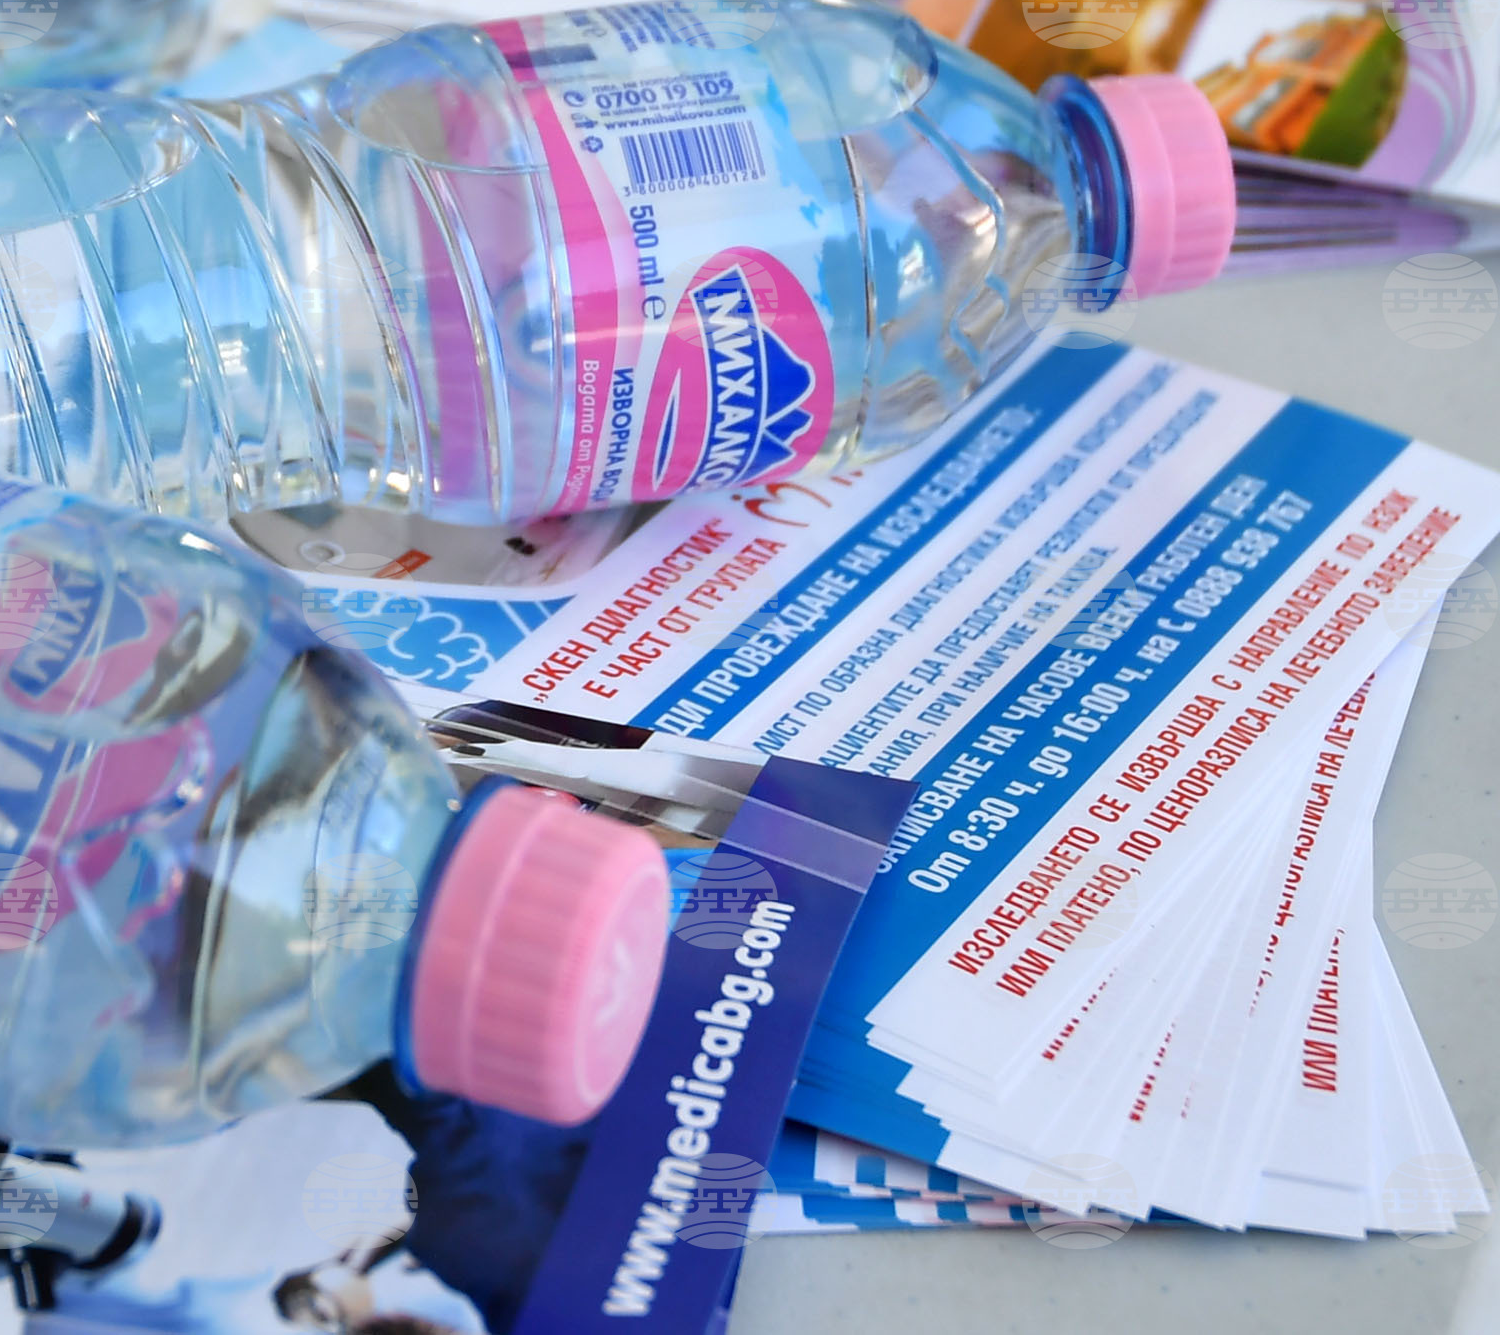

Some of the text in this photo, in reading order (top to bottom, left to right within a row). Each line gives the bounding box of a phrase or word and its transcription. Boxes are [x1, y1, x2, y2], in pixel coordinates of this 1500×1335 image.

[595, 87, 658, 110] 0700
[663, 84, 688, 101] 19
[692, 78, 735, 97] 109
[604, 104, 747, 130] www.mihalkovo.com
[630, 204, 659, 248] 500
[638, 257, 664, 287] ml
[605, 367, 633, 468] ИЗВОРНА
[702, 291, 756, 488] МИХАЛКО
[583, 538, 788, 700] Е ЧАСТ ОТ ГРУПАТА
[700, 569, 860, 705] ПРОВЕЖДАНЕ
[836, 542, 891, 576] НА
[794, 691, 831, 717] ПО
[821, 628, 904, 692] ОБРАЗНА
[890, 529, 1005, 631] ДИАГНОСТИКА
[908, 851, 972, 894] От
[948, 797, 1020, 852] 8:30
[1028, 745, 1073, 779] до
[1052, 681, 1131, 743] 16:00
[1136, 634, 1180, 664] на
[1173, 565, 1243, 618] 0888
[1221, 527, 1280, 570] 938
[1256, 489, 1313, 532] 767
[910, 658, 949, 685] ДА
[972, 724, 1025, 756] НА
[1002, 649, 1098, 720] ЧАСОВЕ
[1074, 588, 1156, 651] ВСЕКИ
[868, 728, 937, 777] АНИЯ,
[917, 691, 967, 727] ПРИ
[951, 621, 1038, 693] НАЛИЧИЕ
[948, 826, 1101, 976] ИЗСЛЕДВАНЕТО
[1088, 793, 1131, 824] СЕ
[1116, 694, 1226, 793] ИЗВЪРШВА
[1211, 674, 1243, 692] С
[1228, 559, 1351, 674] НАПРАВЛЕНИЕ
[1335, 533, 1376, 561] ПО
[1315, 751, 1345, 779] НА
[996, 947, 1056, 998] ИЛИ
[1035, 863, 1142, 953] ПЛАТЕНО,
[1117, 830, 1162, 862] ПО
[1143, 707, 1276, 834] ЦЕНОРАЗПИСА
[1257, 681, 1301, 710] НА
[1282, 592, 1380, 685] ЛЕЧЕБНОТО
[603, 899, 796, 1316] www.medicabg.com
[1301, 1039, 1337, 1093] ИЛИ
